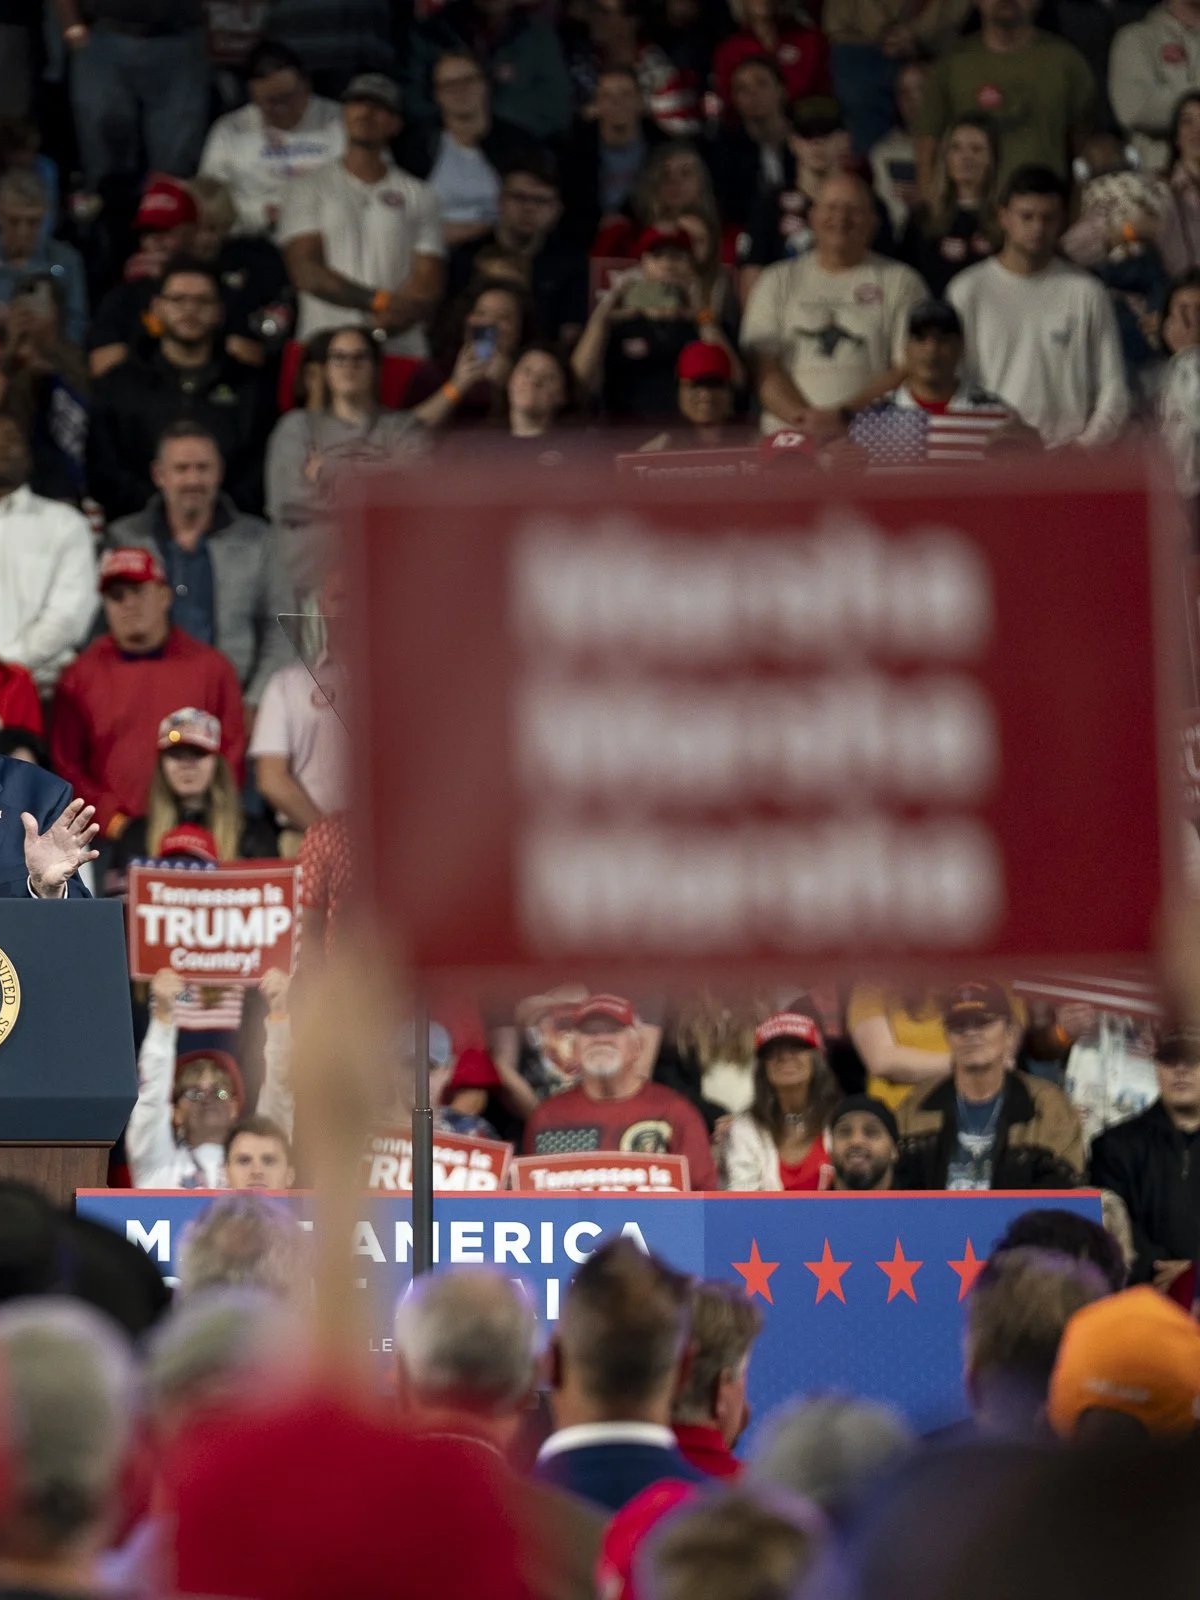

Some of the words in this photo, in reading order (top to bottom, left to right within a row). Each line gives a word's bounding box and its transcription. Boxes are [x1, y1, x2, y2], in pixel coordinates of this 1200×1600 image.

[147, 881, 262, 907] Tennessee
[136, 904, 292, 948] TRUMP
[169, 947, 262, 976] Country!
[529, 1167, 647, 1189] Tennessee
